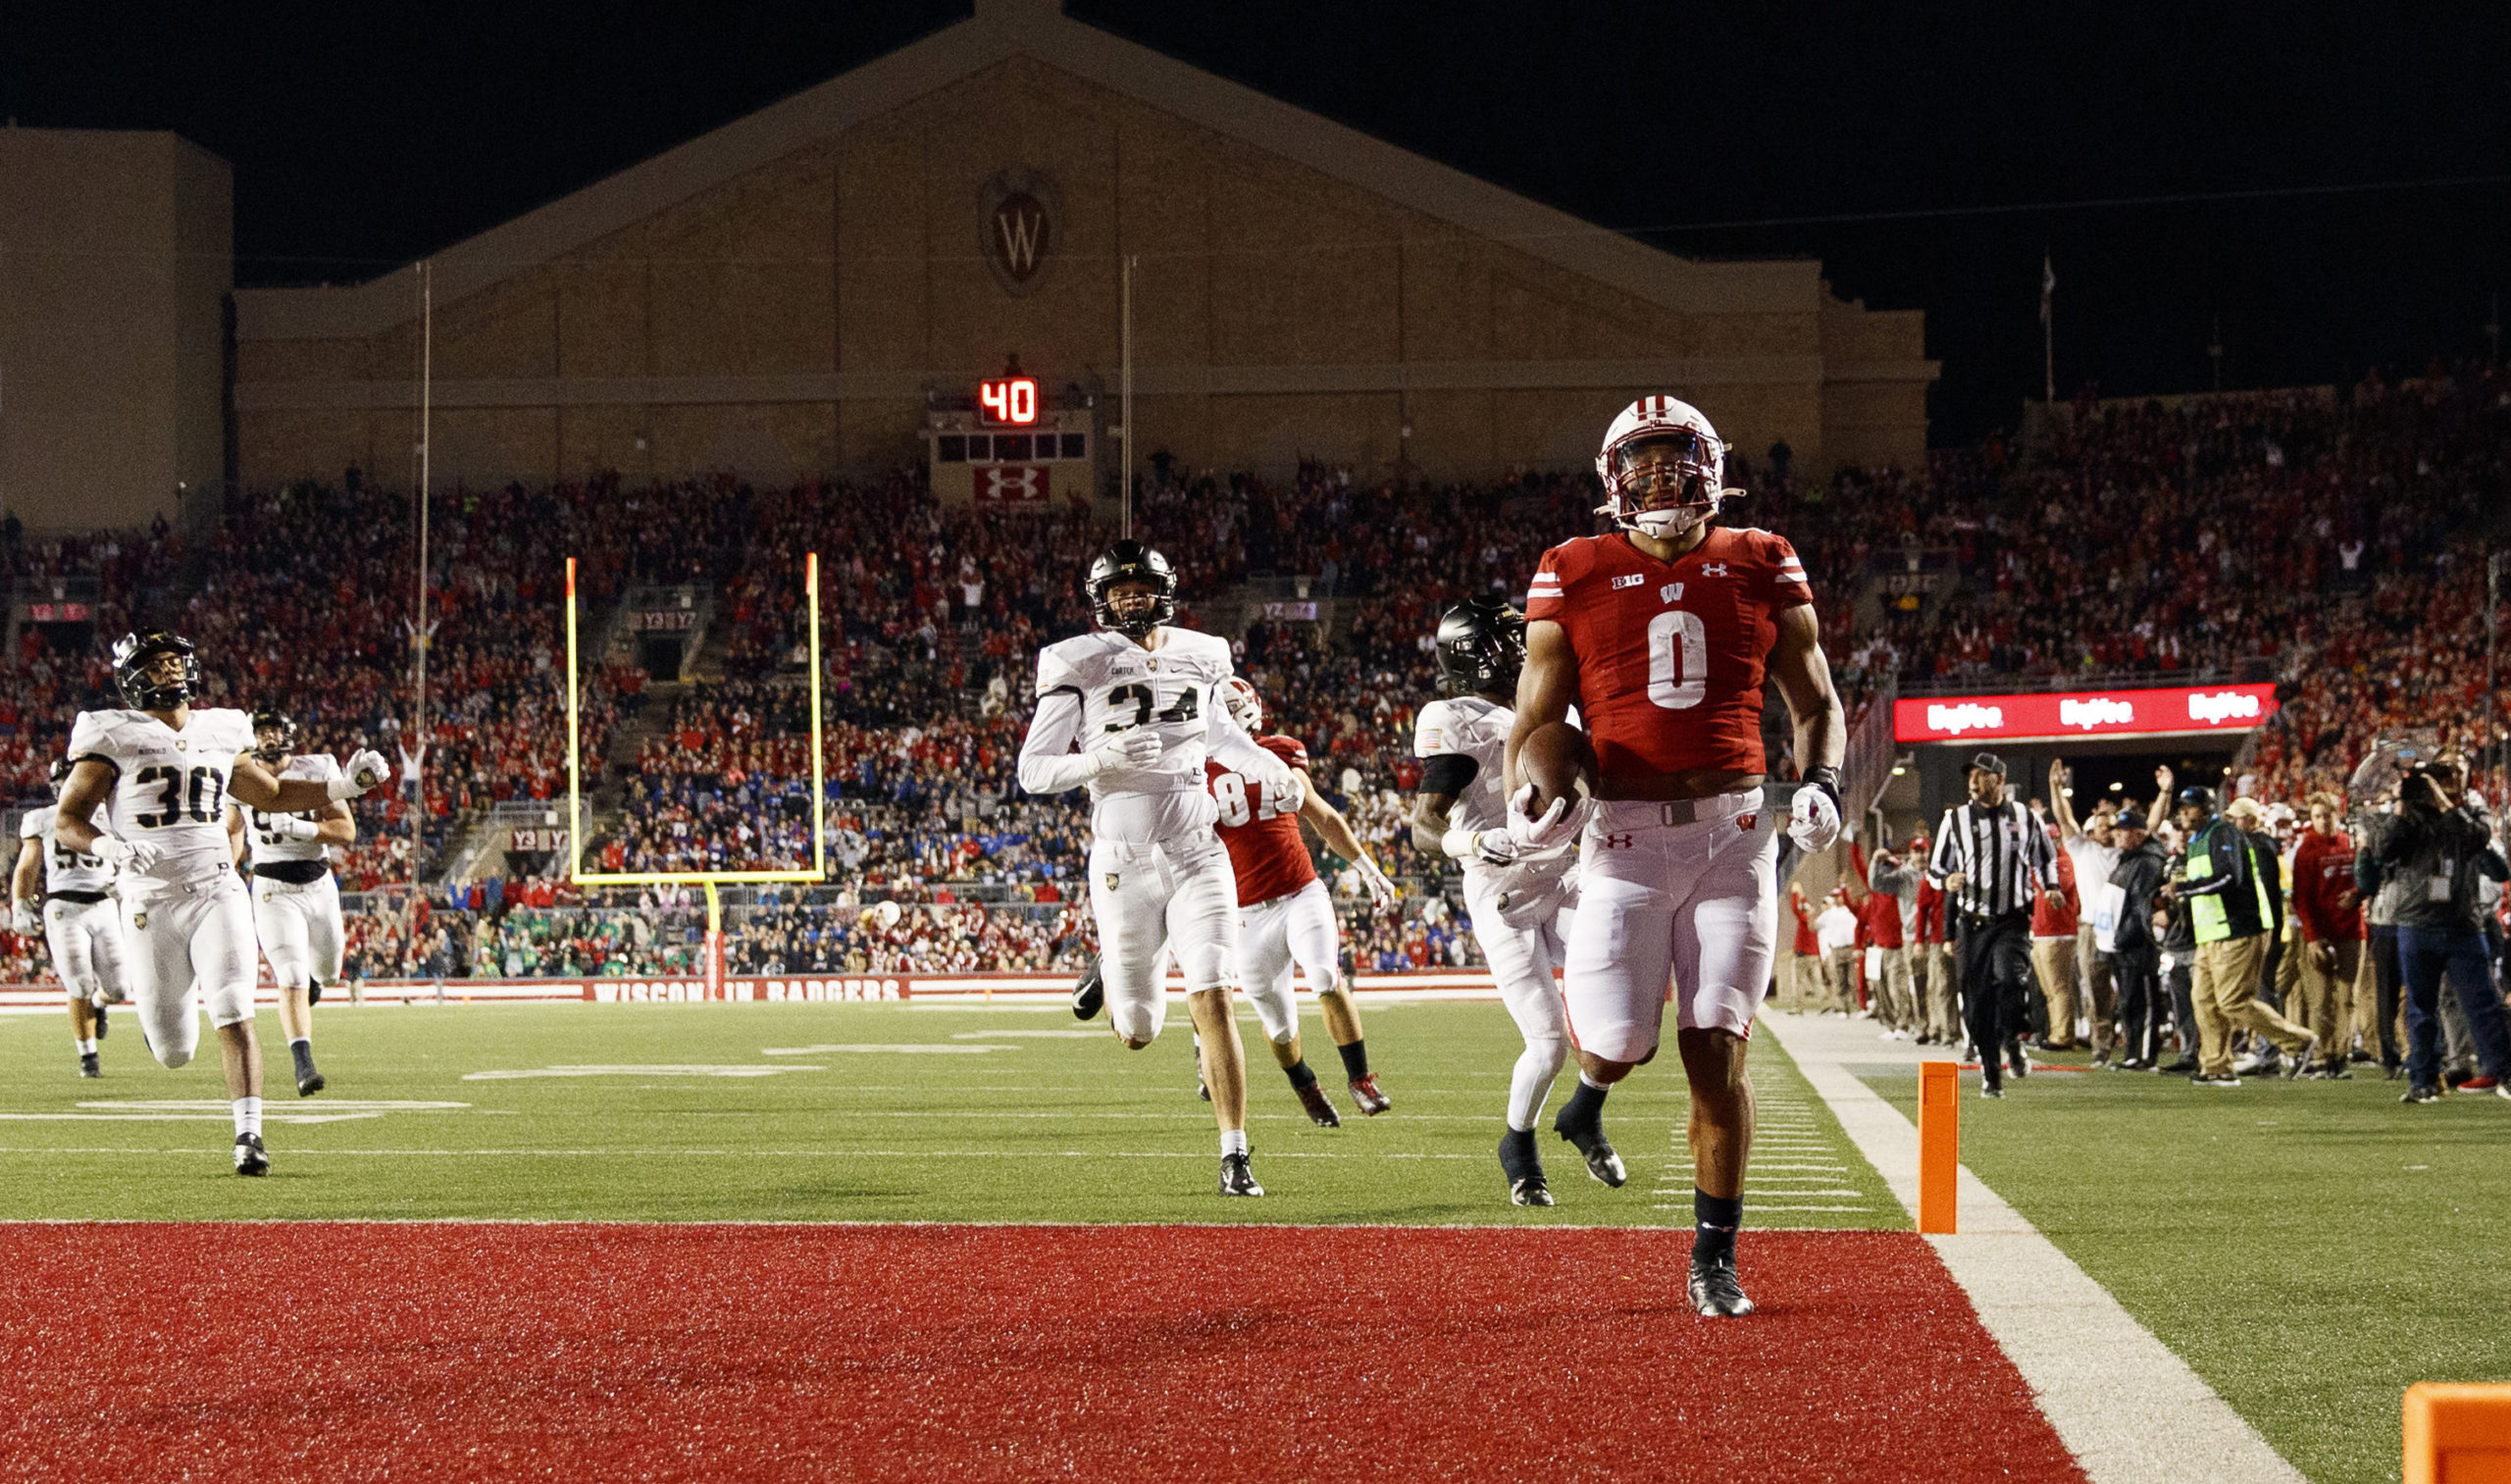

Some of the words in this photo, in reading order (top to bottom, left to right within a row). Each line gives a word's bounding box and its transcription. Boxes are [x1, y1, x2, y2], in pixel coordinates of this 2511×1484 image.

[999, 207, 1042, 272] W
[982, 380, 1035, 423] 40
[1660, 583, 1684, 604] W
[1648, 610, 1707, 709] 0
[1104, 684, 1199, 734] 34
[135, 766, 224, 828] 30
[594, 982, 753, 1002] WISCONIN
[767, 980, 899, 1001] BADGERS
